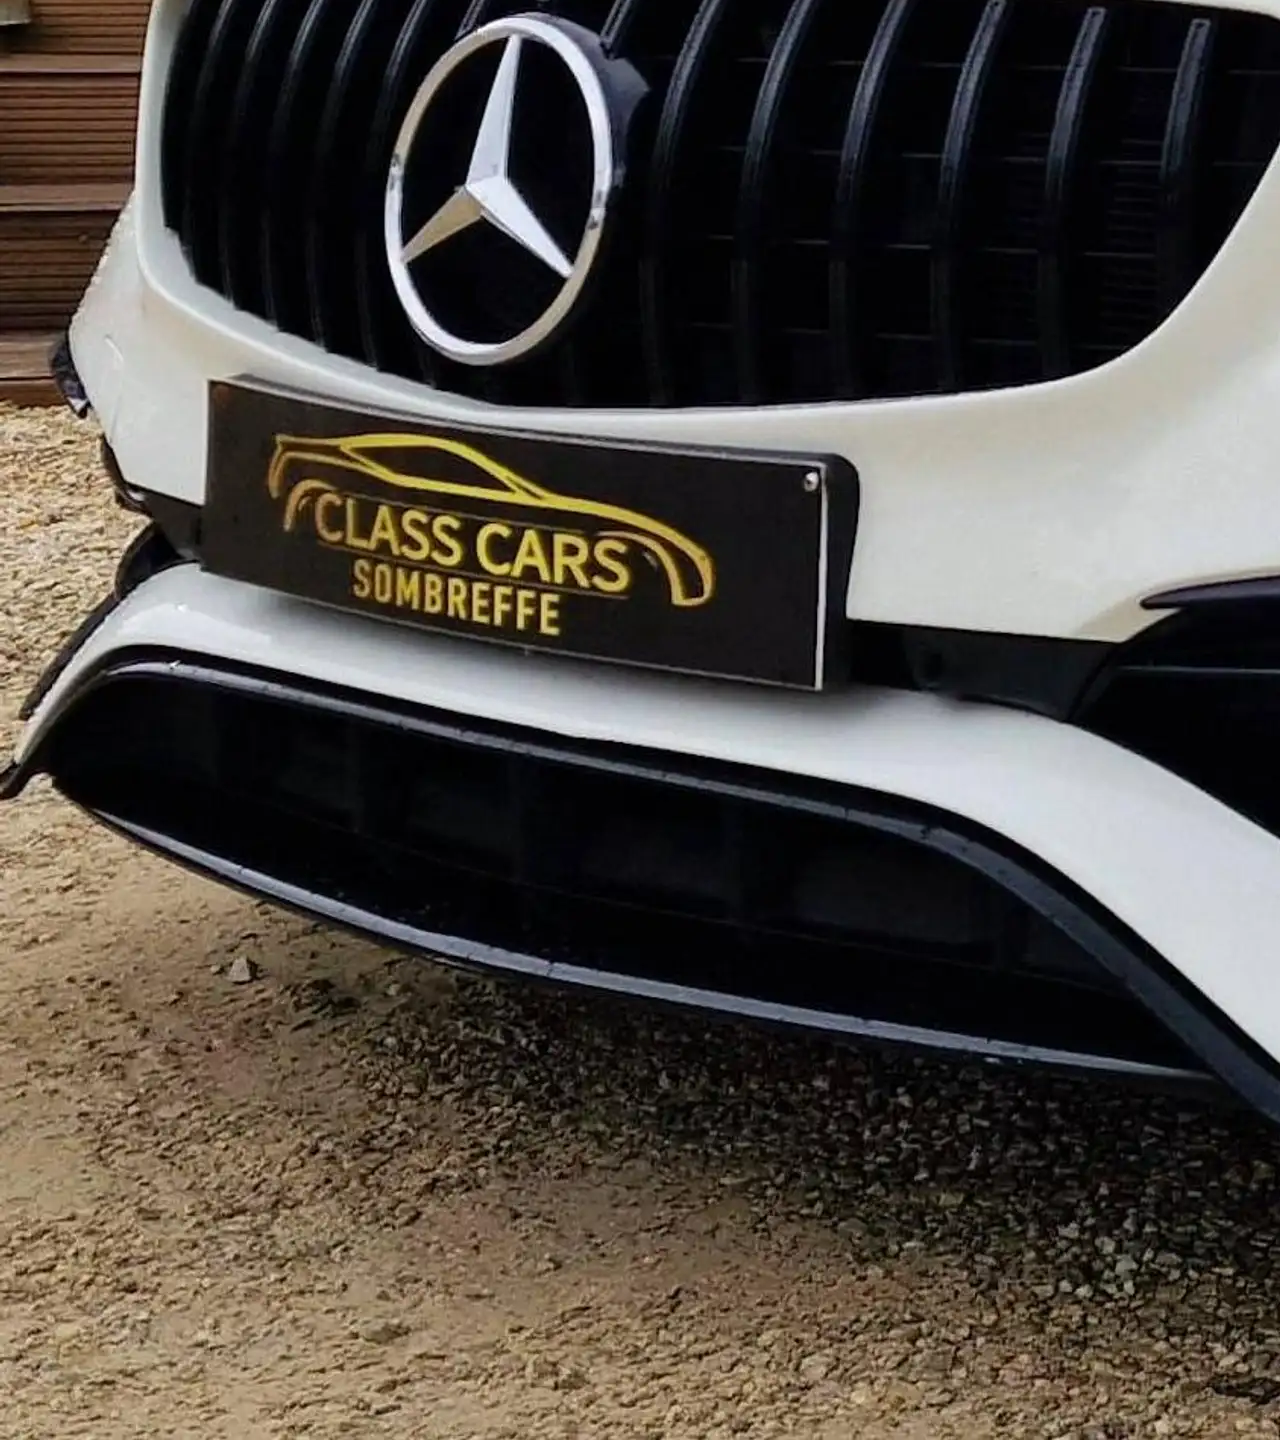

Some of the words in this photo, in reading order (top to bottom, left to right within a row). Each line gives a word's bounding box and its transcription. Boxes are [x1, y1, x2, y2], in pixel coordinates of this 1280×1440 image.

[314, 491, 464, 568] CLASS
[476, 522, 632, 594] CARS
[352, 559, 562, 637] SOMBREFFE
